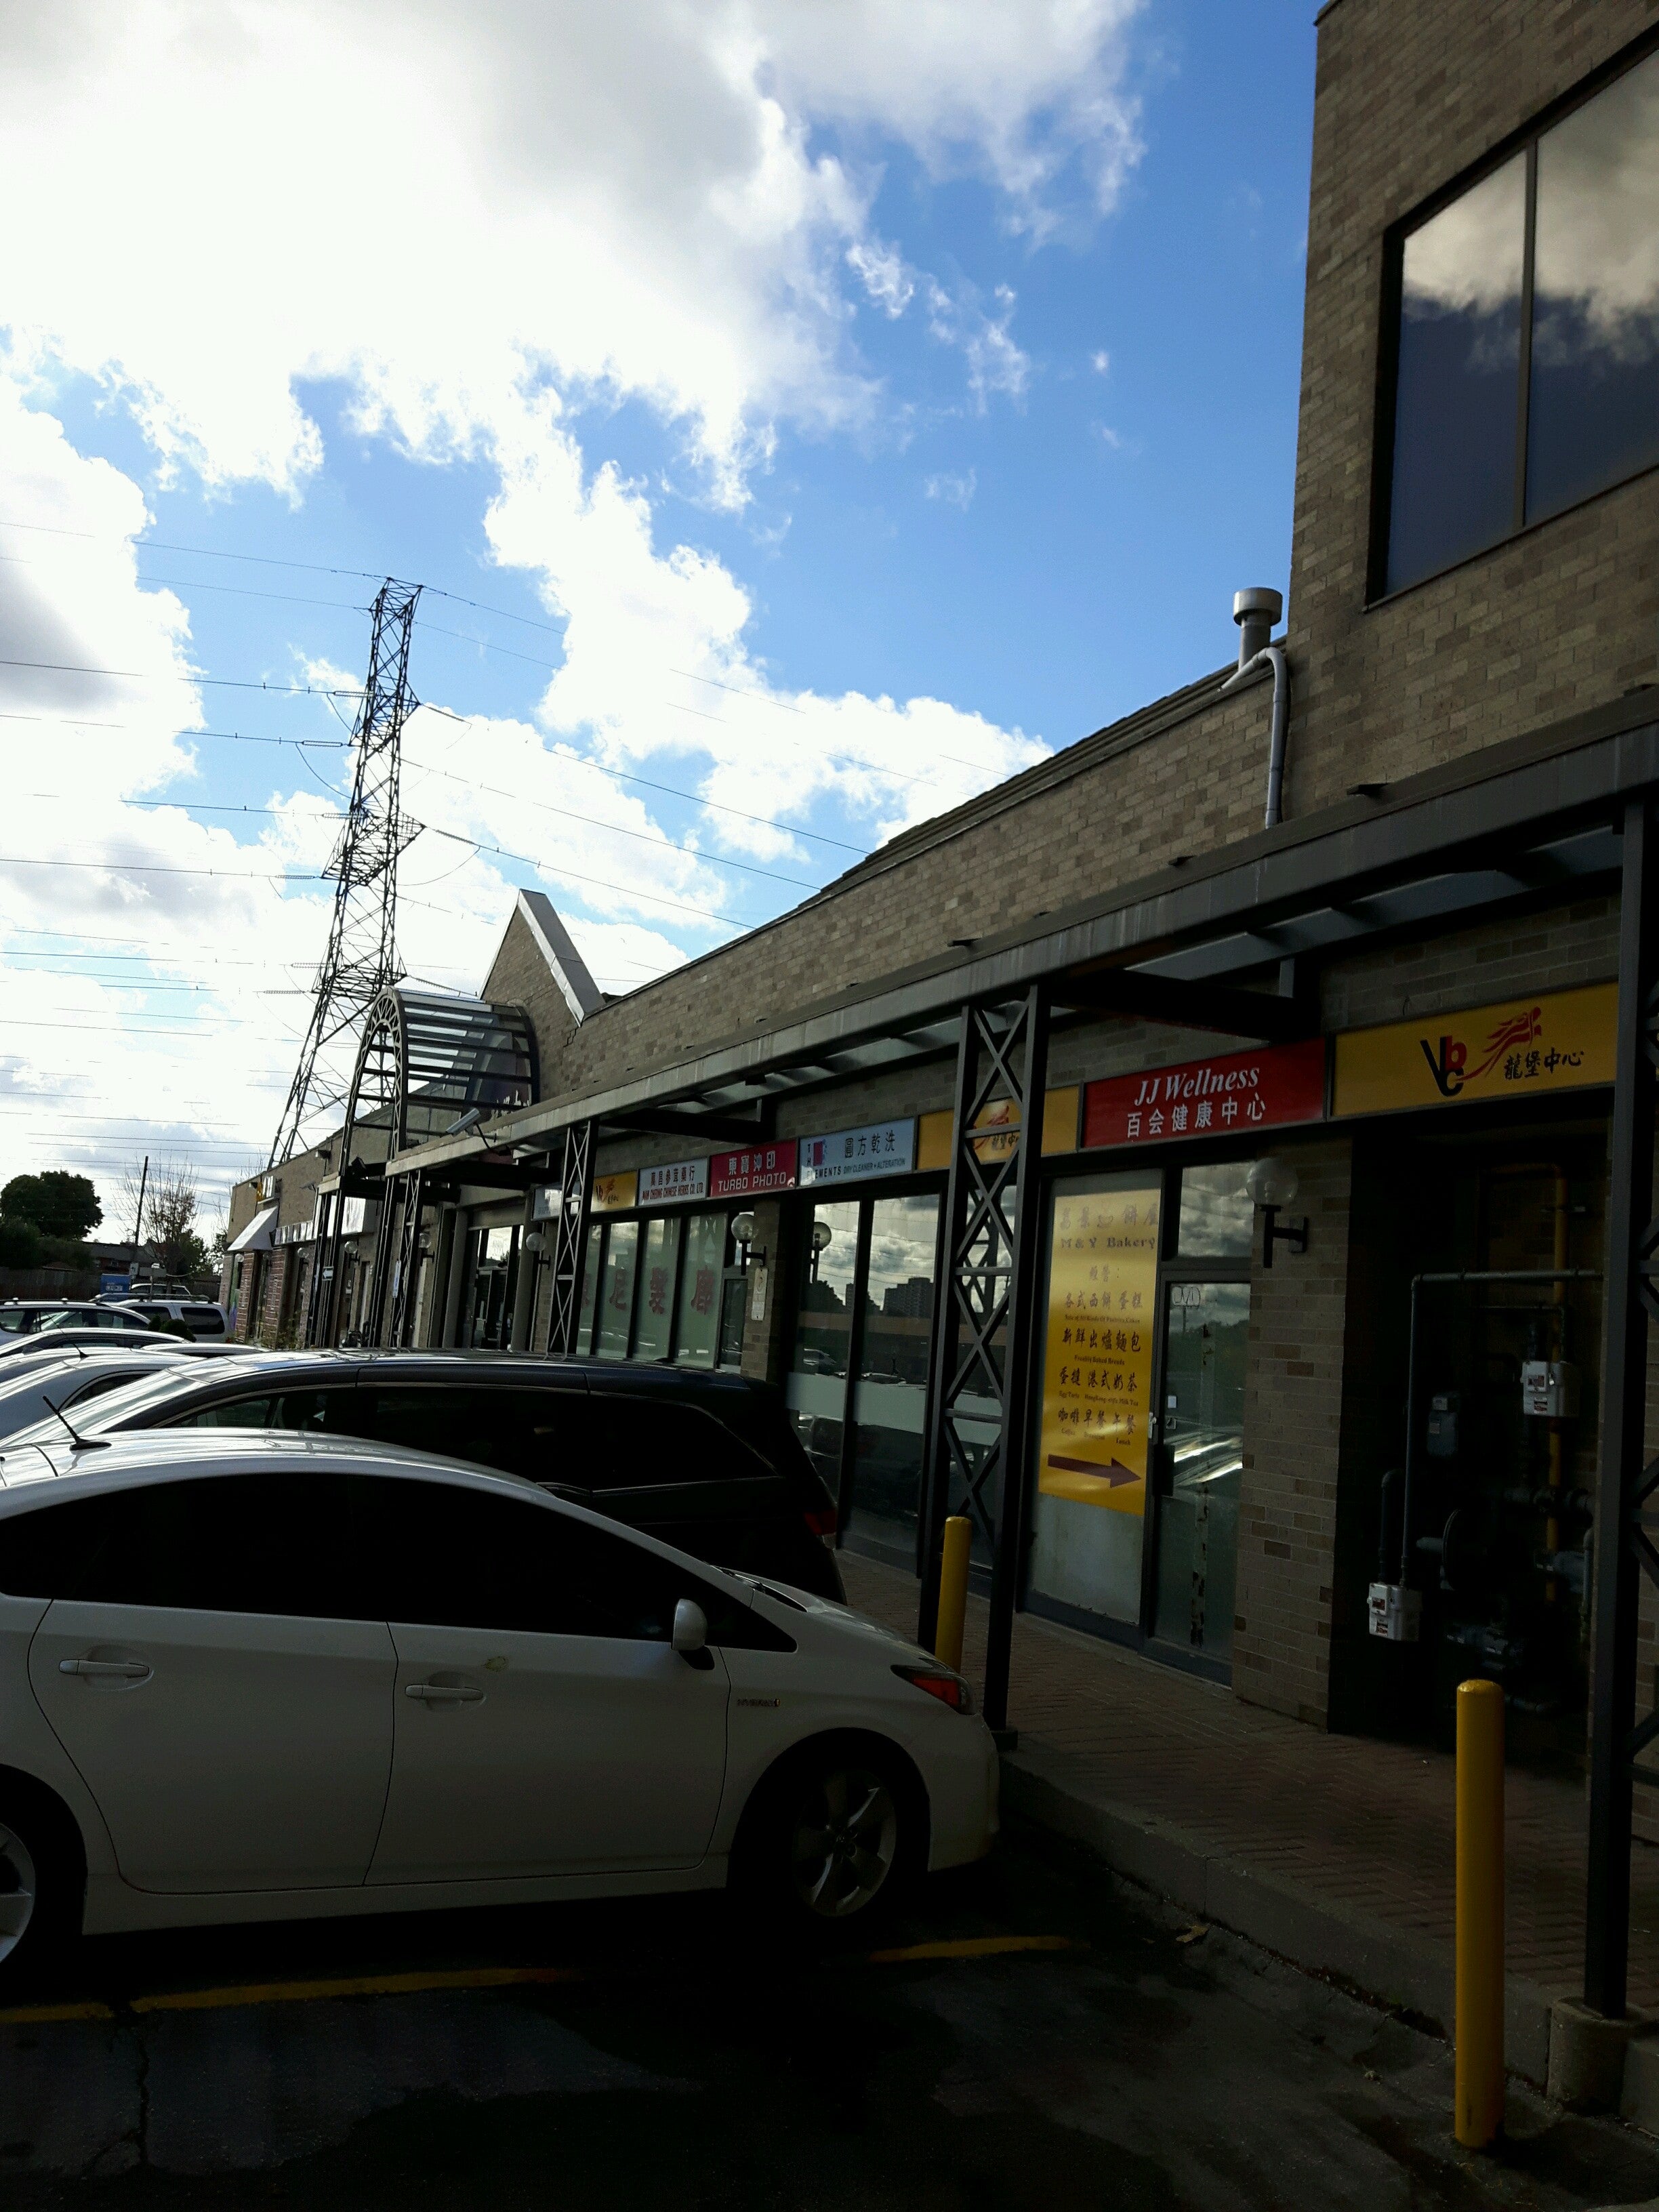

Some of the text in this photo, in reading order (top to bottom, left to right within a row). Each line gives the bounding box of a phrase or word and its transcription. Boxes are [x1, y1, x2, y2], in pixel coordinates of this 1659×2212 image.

[1504, 1047, 1584, 1080] 龍堡中心
[1134, 1067, 1261, 1107] JJ Wellness
[1126, 1092, 1266, 1139] 百会健康中心
[844, 1130, 895, 1158] 圓方乾洗
[718, 1172, 786, 1192] TURBO PHOTO
[1107, 1237, 1155, 1249] Bakery
